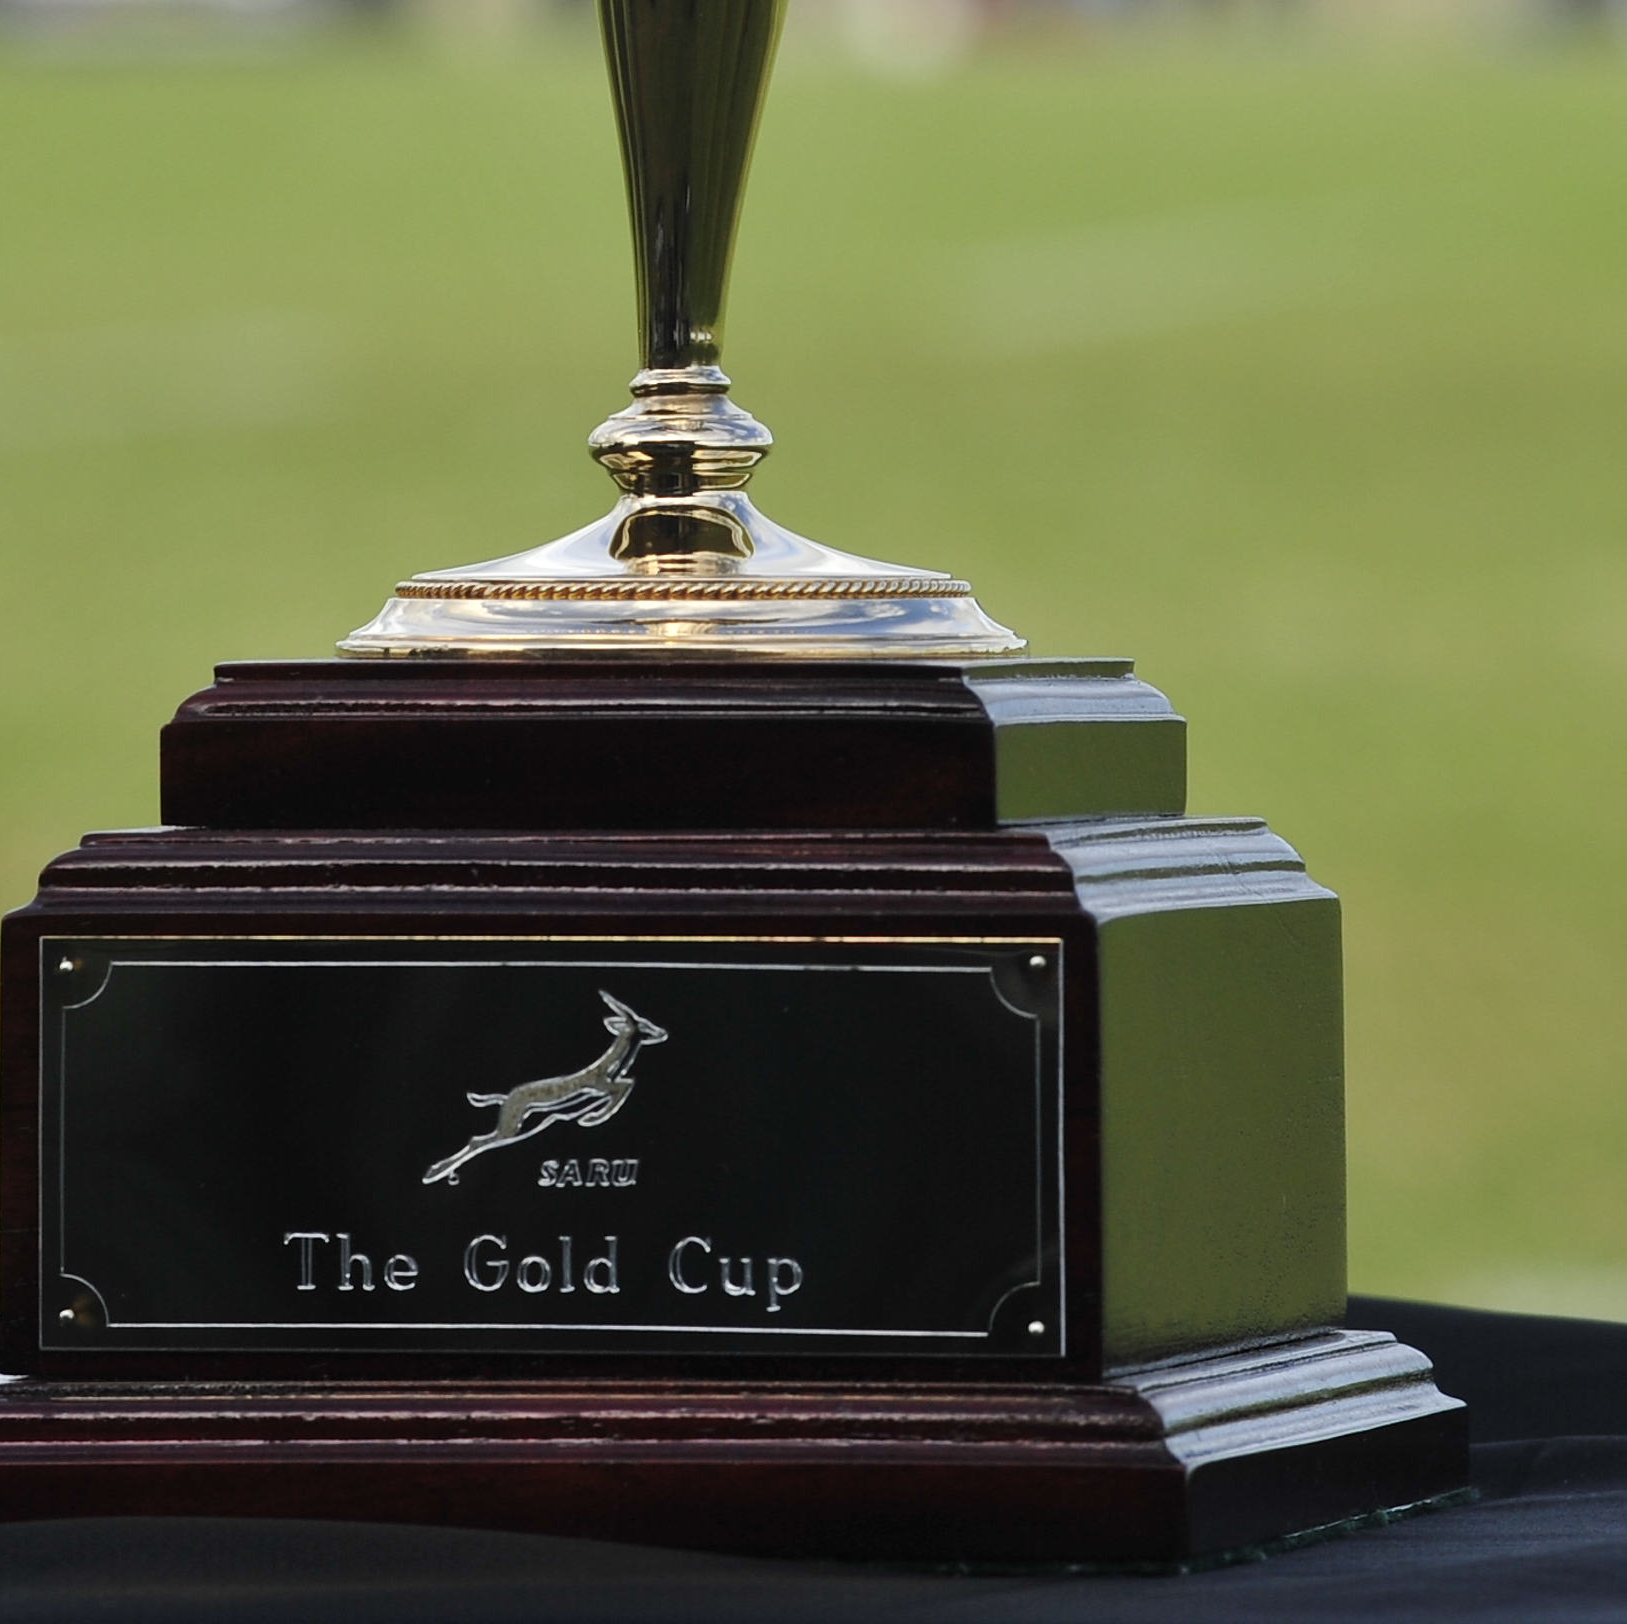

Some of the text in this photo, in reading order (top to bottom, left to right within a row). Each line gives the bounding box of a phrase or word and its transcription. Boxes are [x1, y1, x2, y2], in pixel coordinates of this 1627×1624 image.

[537, 1158, 640, 1188] SARU
[282, 1231, 804, 1313] The Gold Cup
